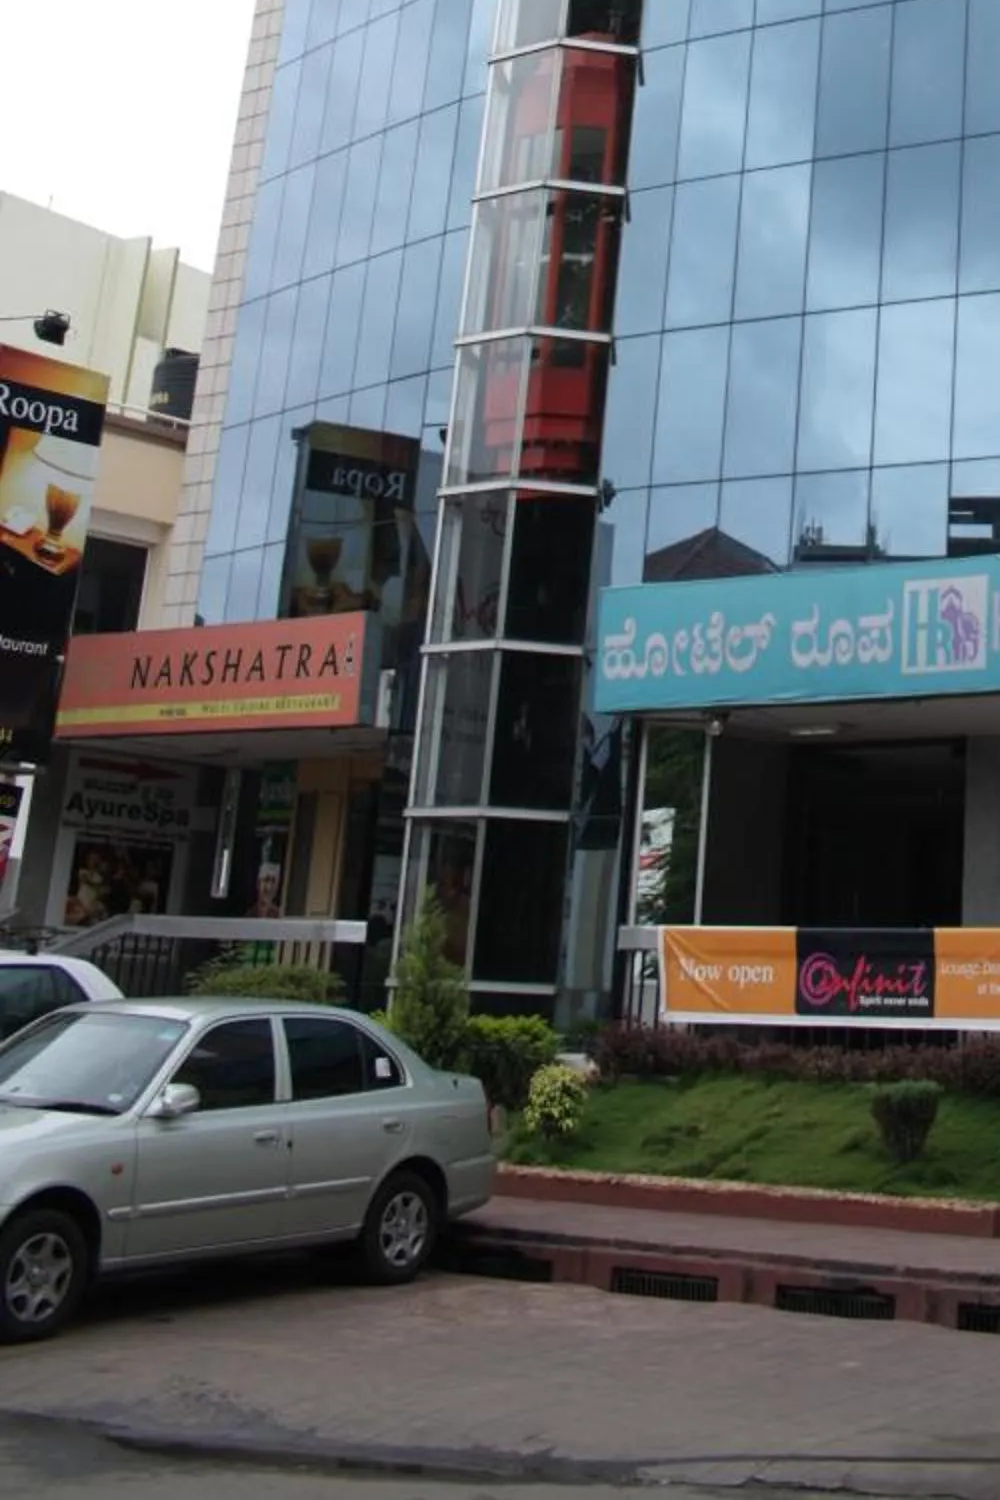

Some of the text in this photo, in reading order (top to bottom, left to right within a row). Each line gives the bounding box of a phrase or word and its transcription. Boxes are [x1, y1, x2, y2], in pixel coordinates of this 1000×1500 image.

[602, 599, 894, 680] ಹೋಟೆಲ್ ರೂಪ
[130, 643, 339, 689] NAKSHATRA
[680, 957, 774, 990] Now open
